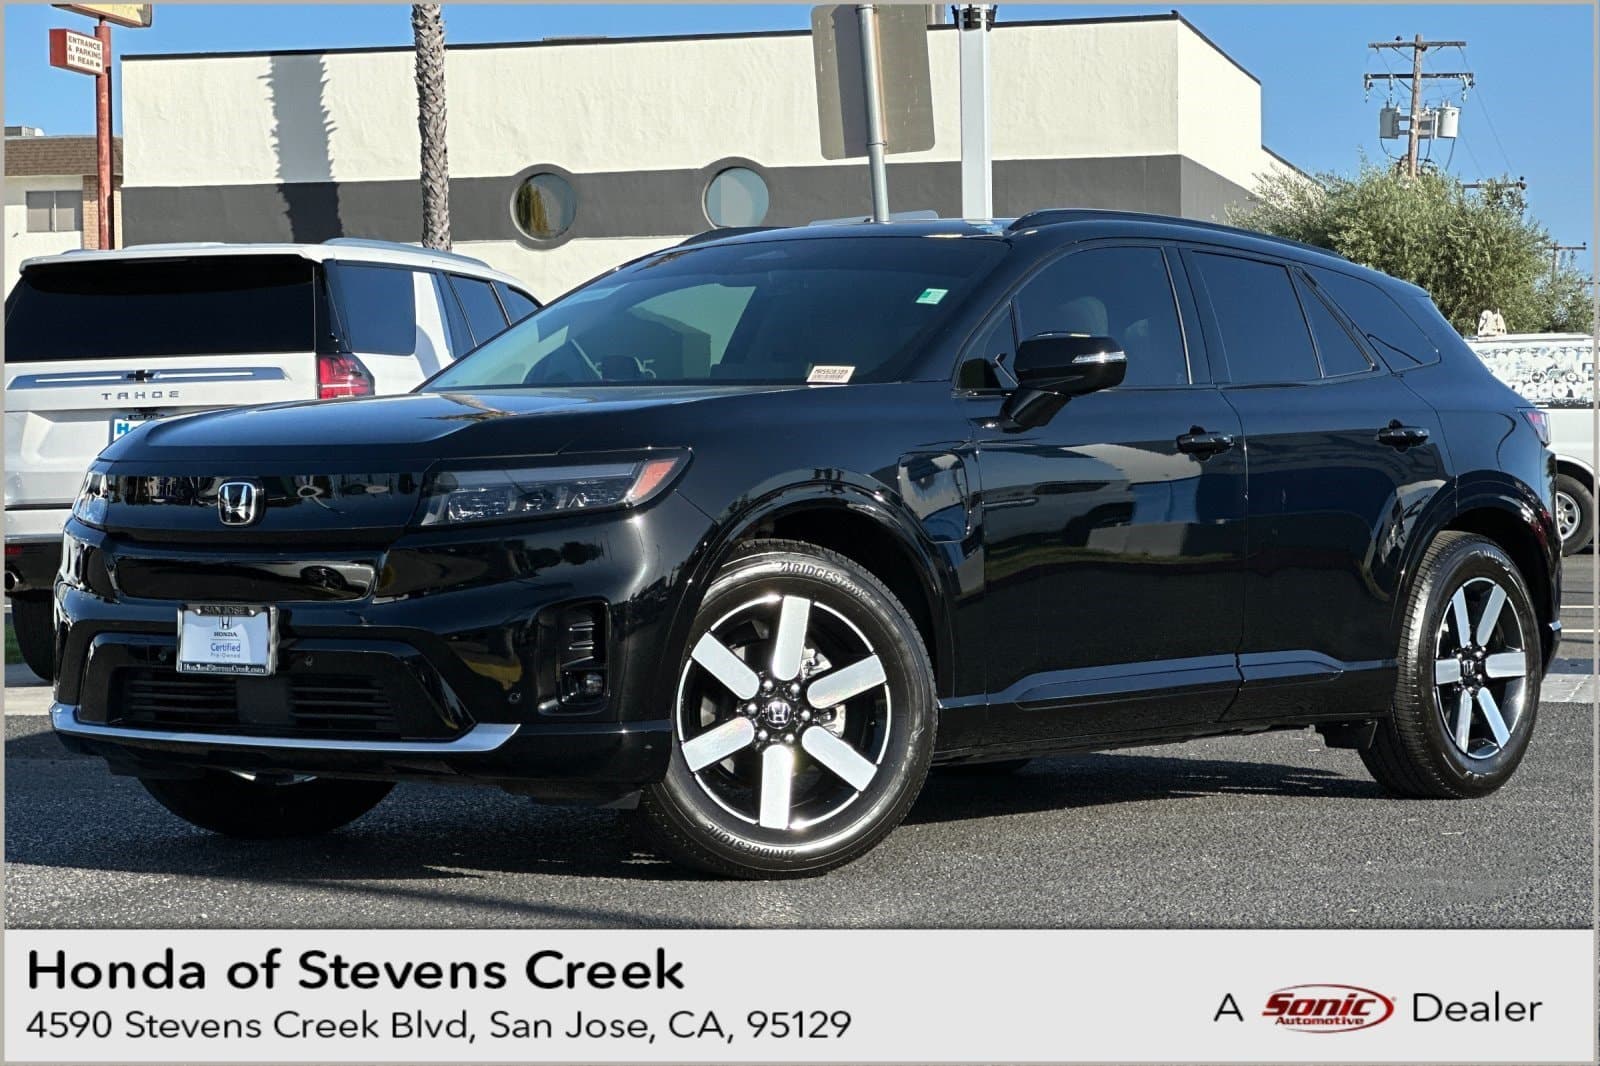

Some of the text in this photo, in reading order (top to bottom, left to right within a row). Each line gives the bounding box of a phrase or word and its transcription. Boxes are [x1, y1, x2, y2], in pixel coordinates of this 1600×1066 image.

[68, 35, 101, 51] ENTRANCE
[75, 46, 102, 60] PARKING
[68, 54, 95, 67] IN REAR
[101, 390, 180, 400] TAHOE
[210, 642, 241, 652] Certified
[703, 823, 795, 859] BRIDGESTONE
